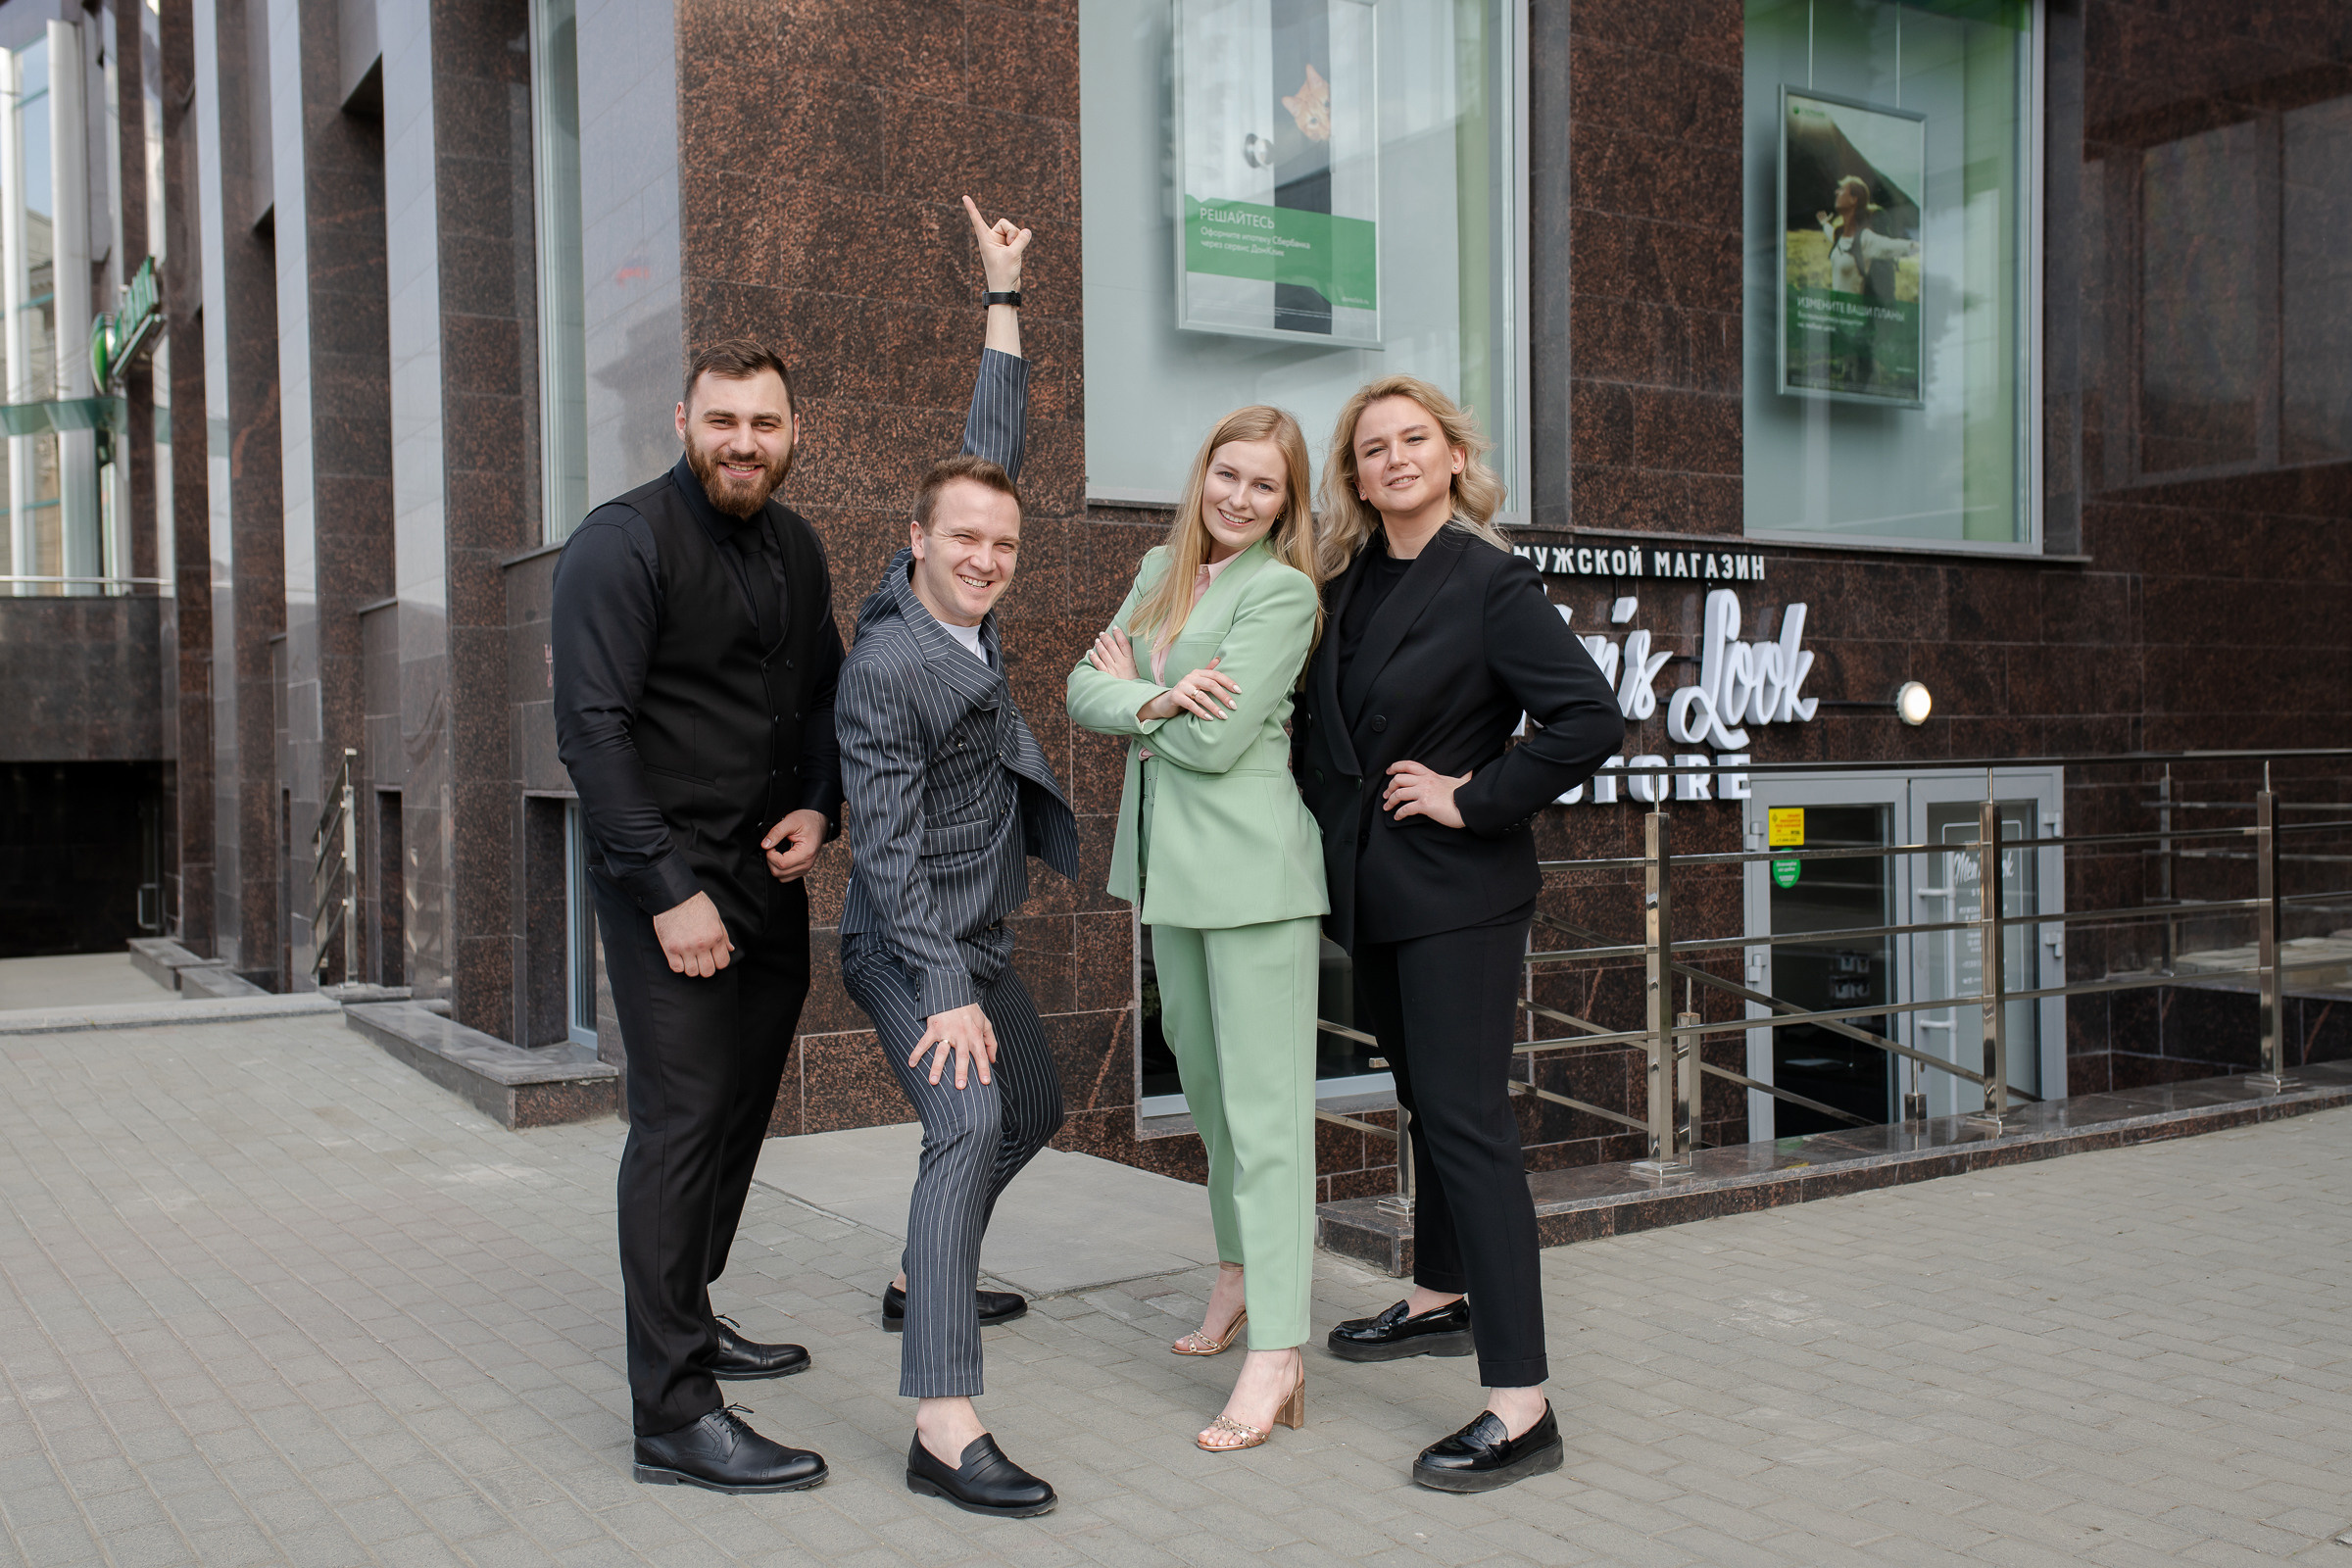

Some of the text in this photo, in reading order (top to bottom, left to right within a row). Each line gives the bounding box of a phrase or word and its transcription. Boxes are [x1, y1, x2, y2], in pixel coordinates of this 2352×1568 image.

[1200, 207, 1275, 229] РЕШАЙТЕСЬ
[1797, 296, 1845, 314] ИЗМЕНИТЕ
[1654, 551, 1766, 580] МАГАЗИН
[1667, 588, 1820, 751] Look
